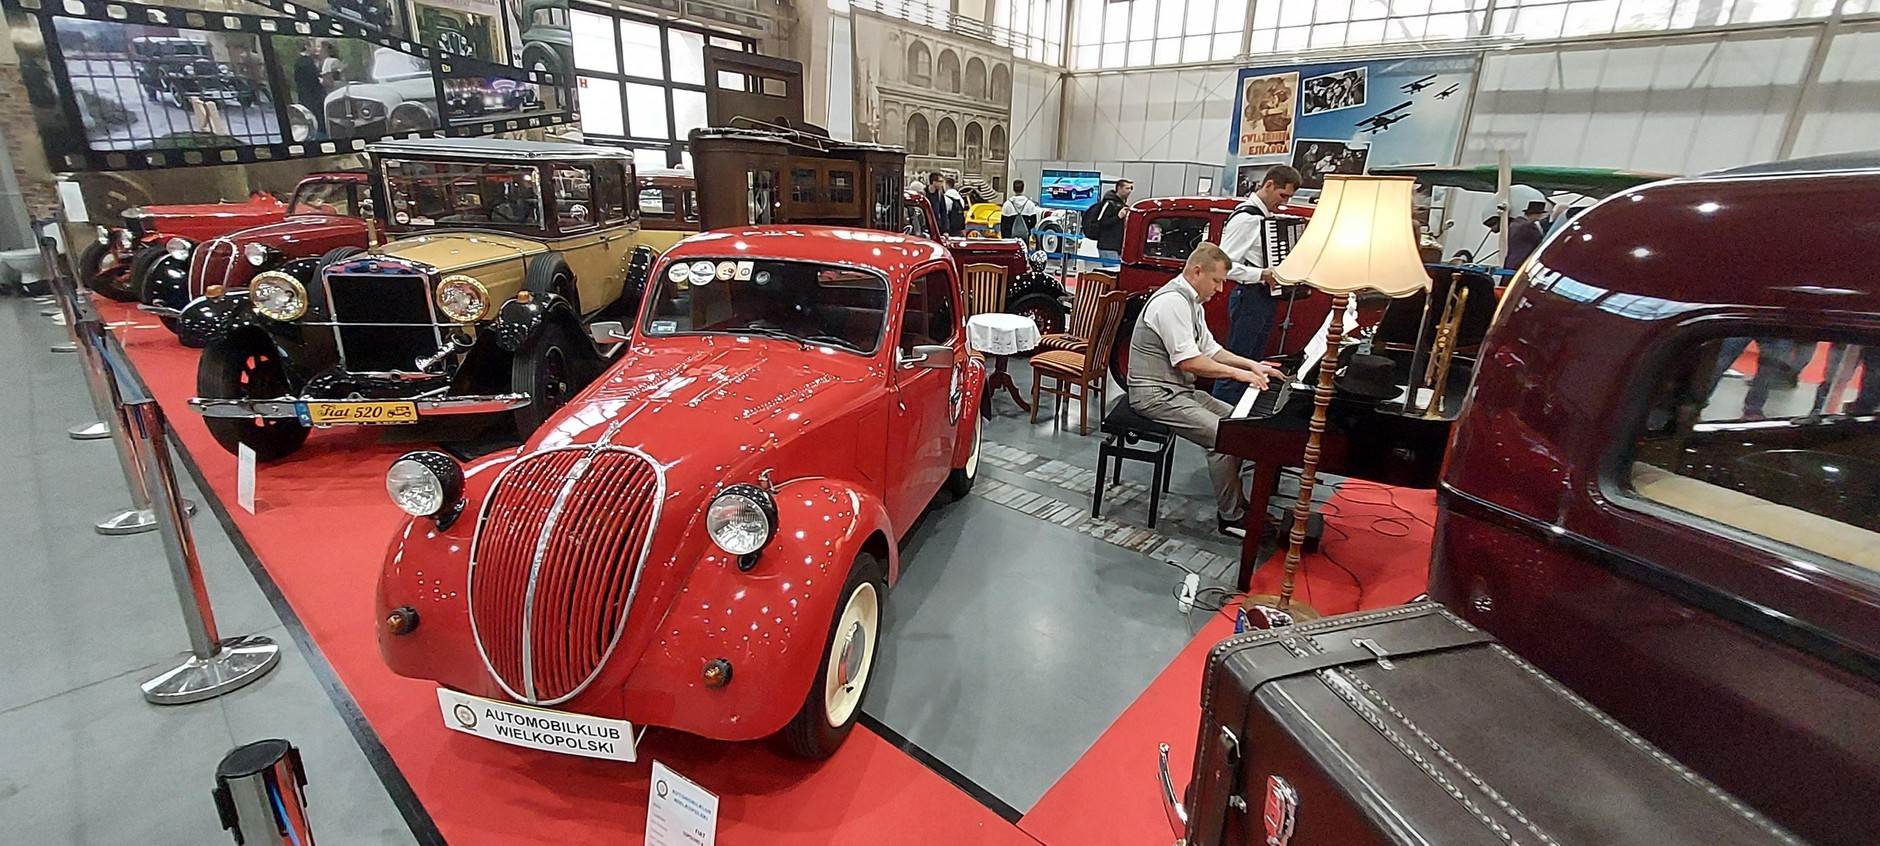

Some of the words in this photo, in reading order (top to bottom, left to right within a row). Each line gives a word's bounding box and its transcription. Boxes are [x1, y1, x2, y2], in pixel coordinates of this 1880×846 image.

[579, 78, 588, 88] H
[318, 404, 350, 418] Fiat
[354, 406, 382, 418] 520
[485, 708, 620, 740] AUTOMOBILKLUB
[494, 724, 615, 754] WIELKOPOLSKI
